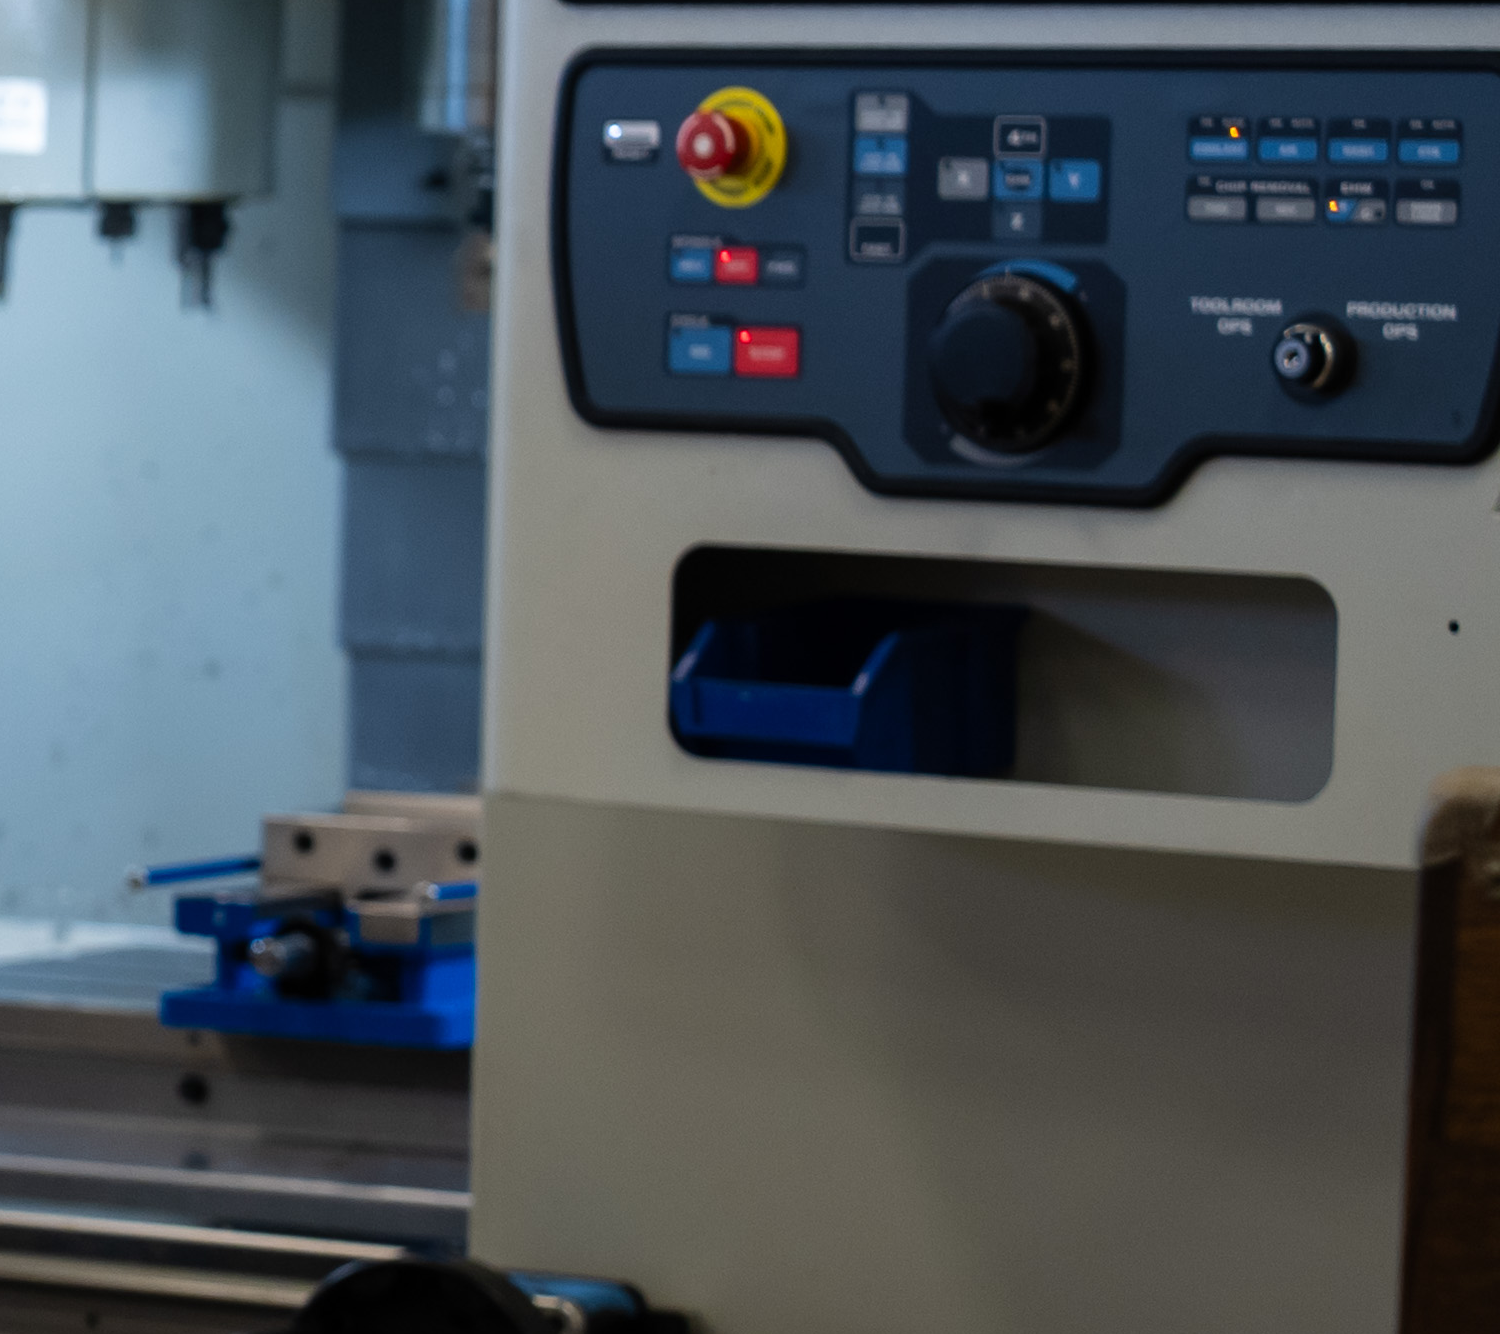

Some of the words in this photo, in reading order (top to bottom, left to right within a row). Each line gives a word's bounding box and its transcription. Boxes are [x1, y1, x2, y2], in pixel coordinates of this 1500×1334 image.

[1190, 296, 1283, 316] TOOLROOM
[1346, 300, 1458, 321] PRODUCTION
[1216, 317, 1253, 336] OPS
[1382, 322, 1419, 341] OPS
